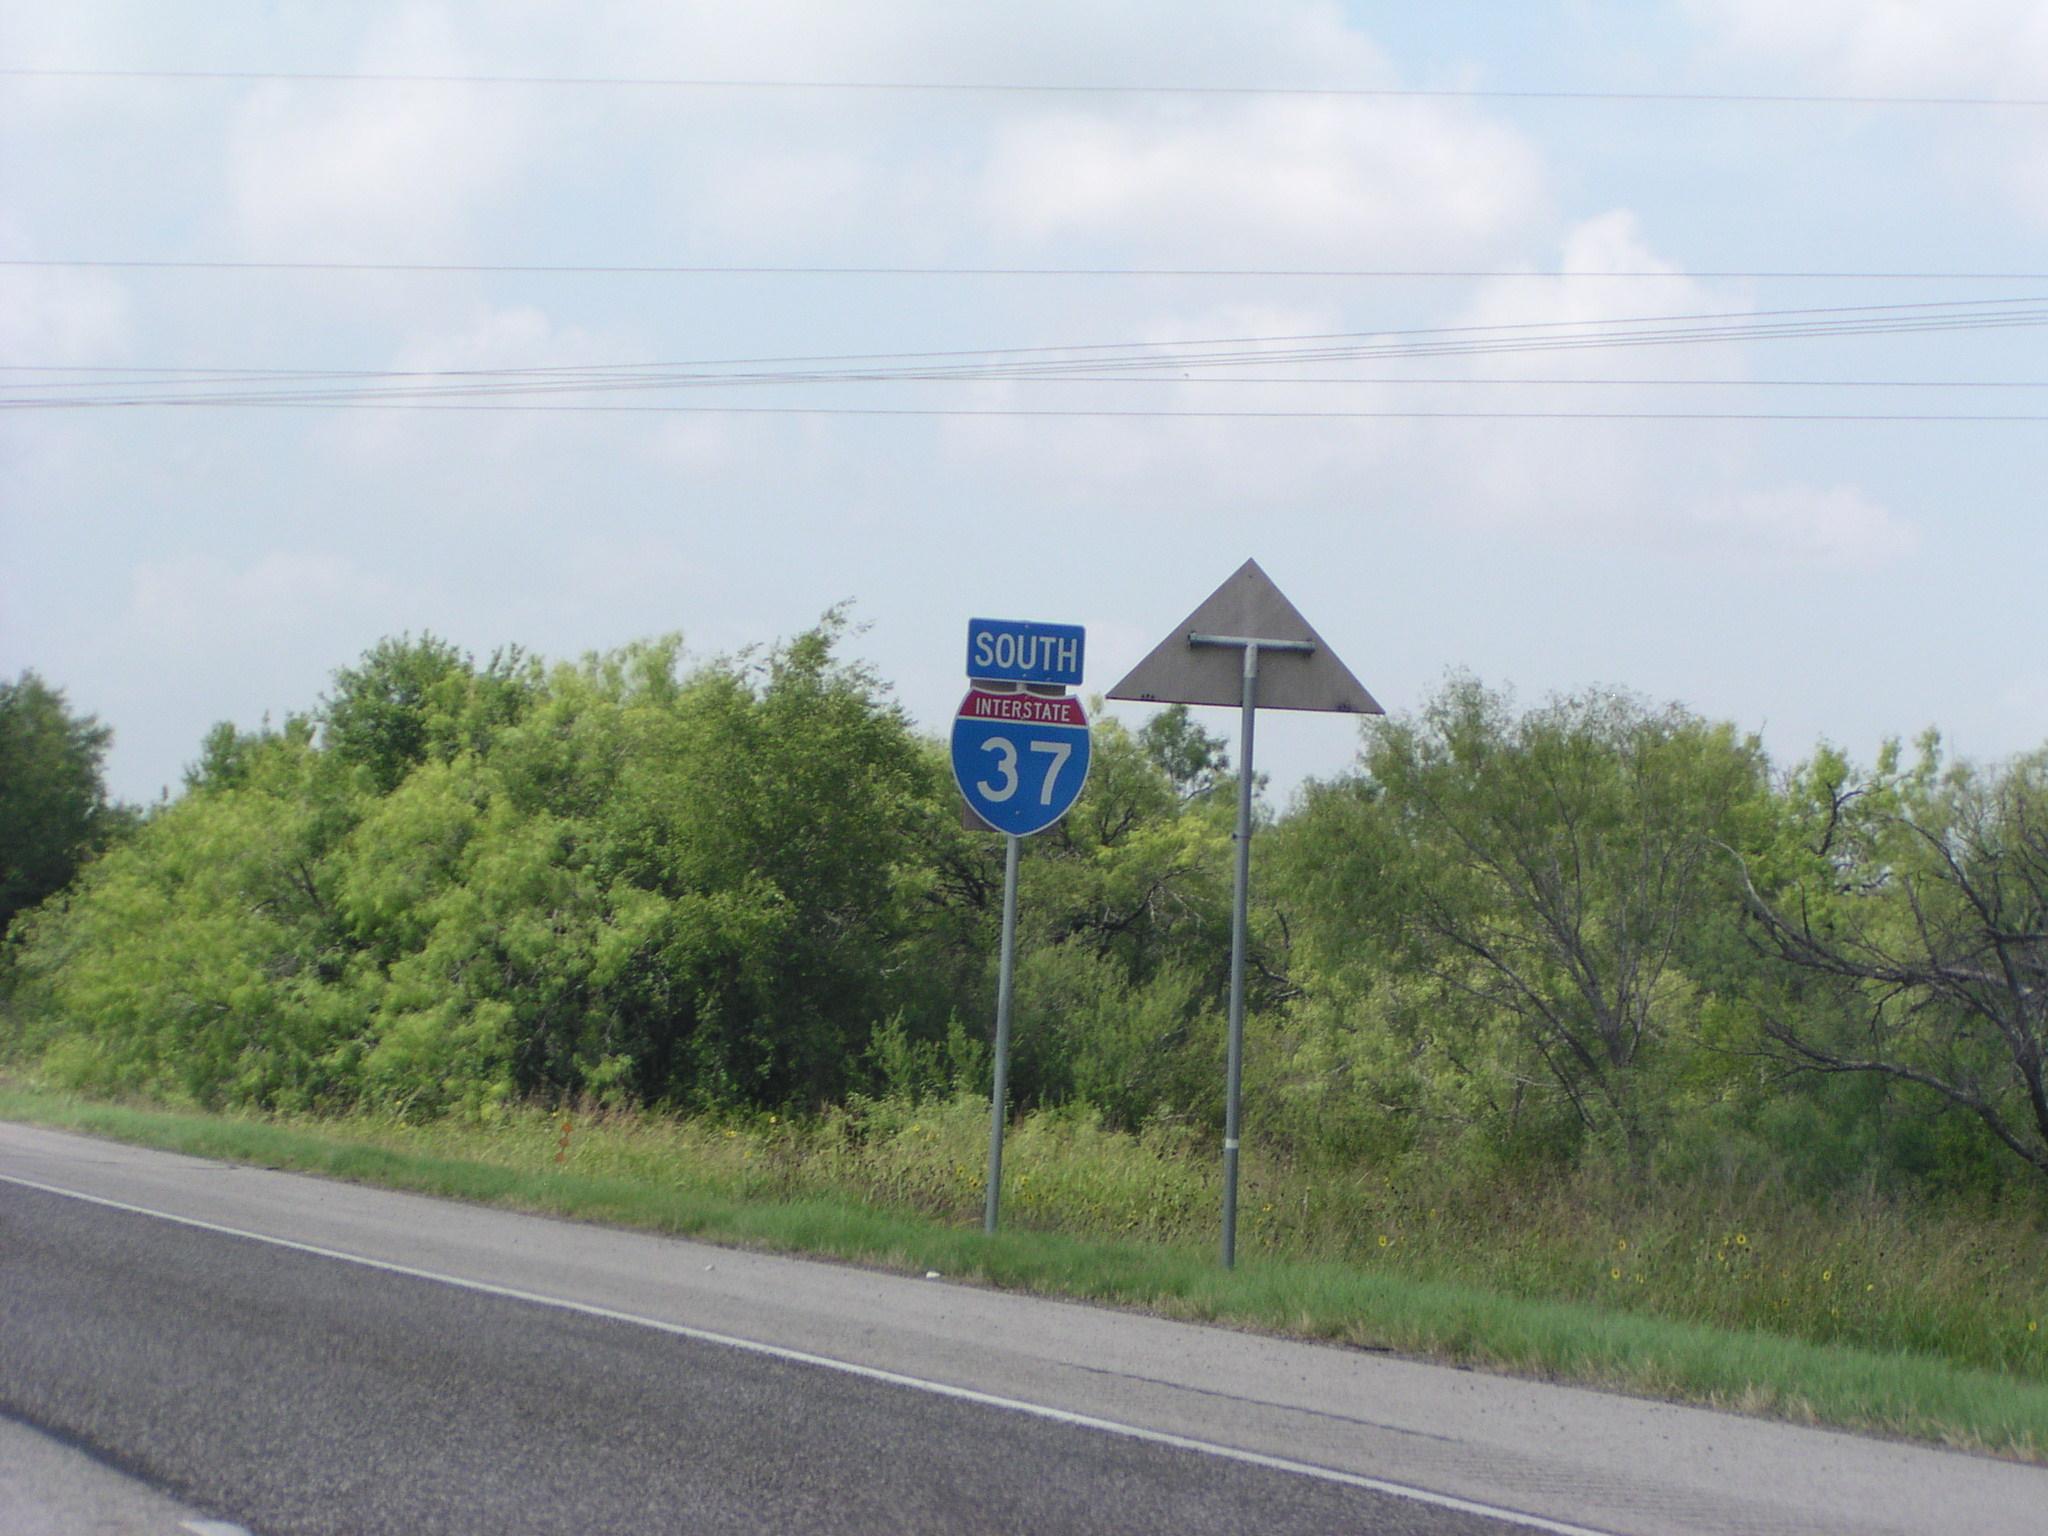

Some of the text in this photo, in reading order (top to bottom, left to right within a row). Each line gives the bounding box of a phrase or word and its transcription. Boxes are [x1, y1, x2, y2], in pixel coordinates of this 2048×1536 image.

[975, 631, 1077, 673] SOUTH
[976, 697, 1071, 722] INTERSTATE
[976, 736, 1072, 805] 37
